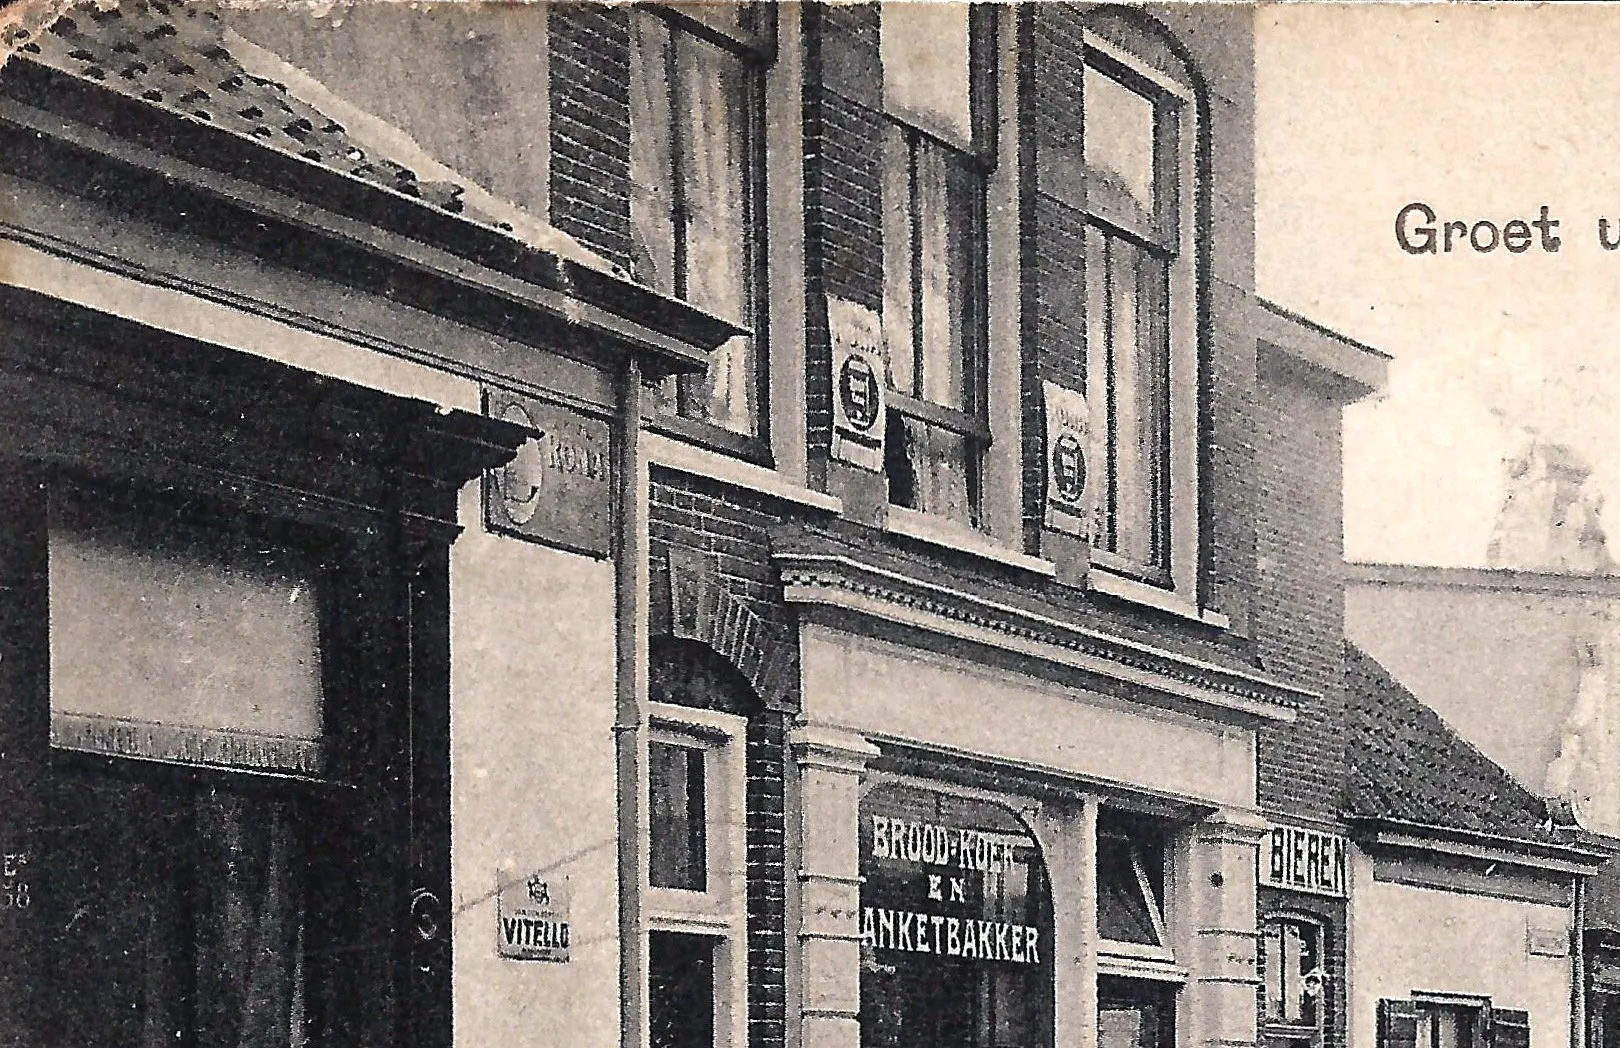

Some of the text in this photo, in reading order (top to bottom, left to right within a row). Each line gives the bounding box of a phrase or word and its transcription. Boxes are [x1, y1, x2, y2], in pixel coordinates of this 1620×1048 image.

[1270, 826, 1348, 895] BIEREN
[927, 873, 966, 904] EN
[502, 916, 570, 950] VITELLO
[860, 905, 1041, 964] ANKETBAKKER
